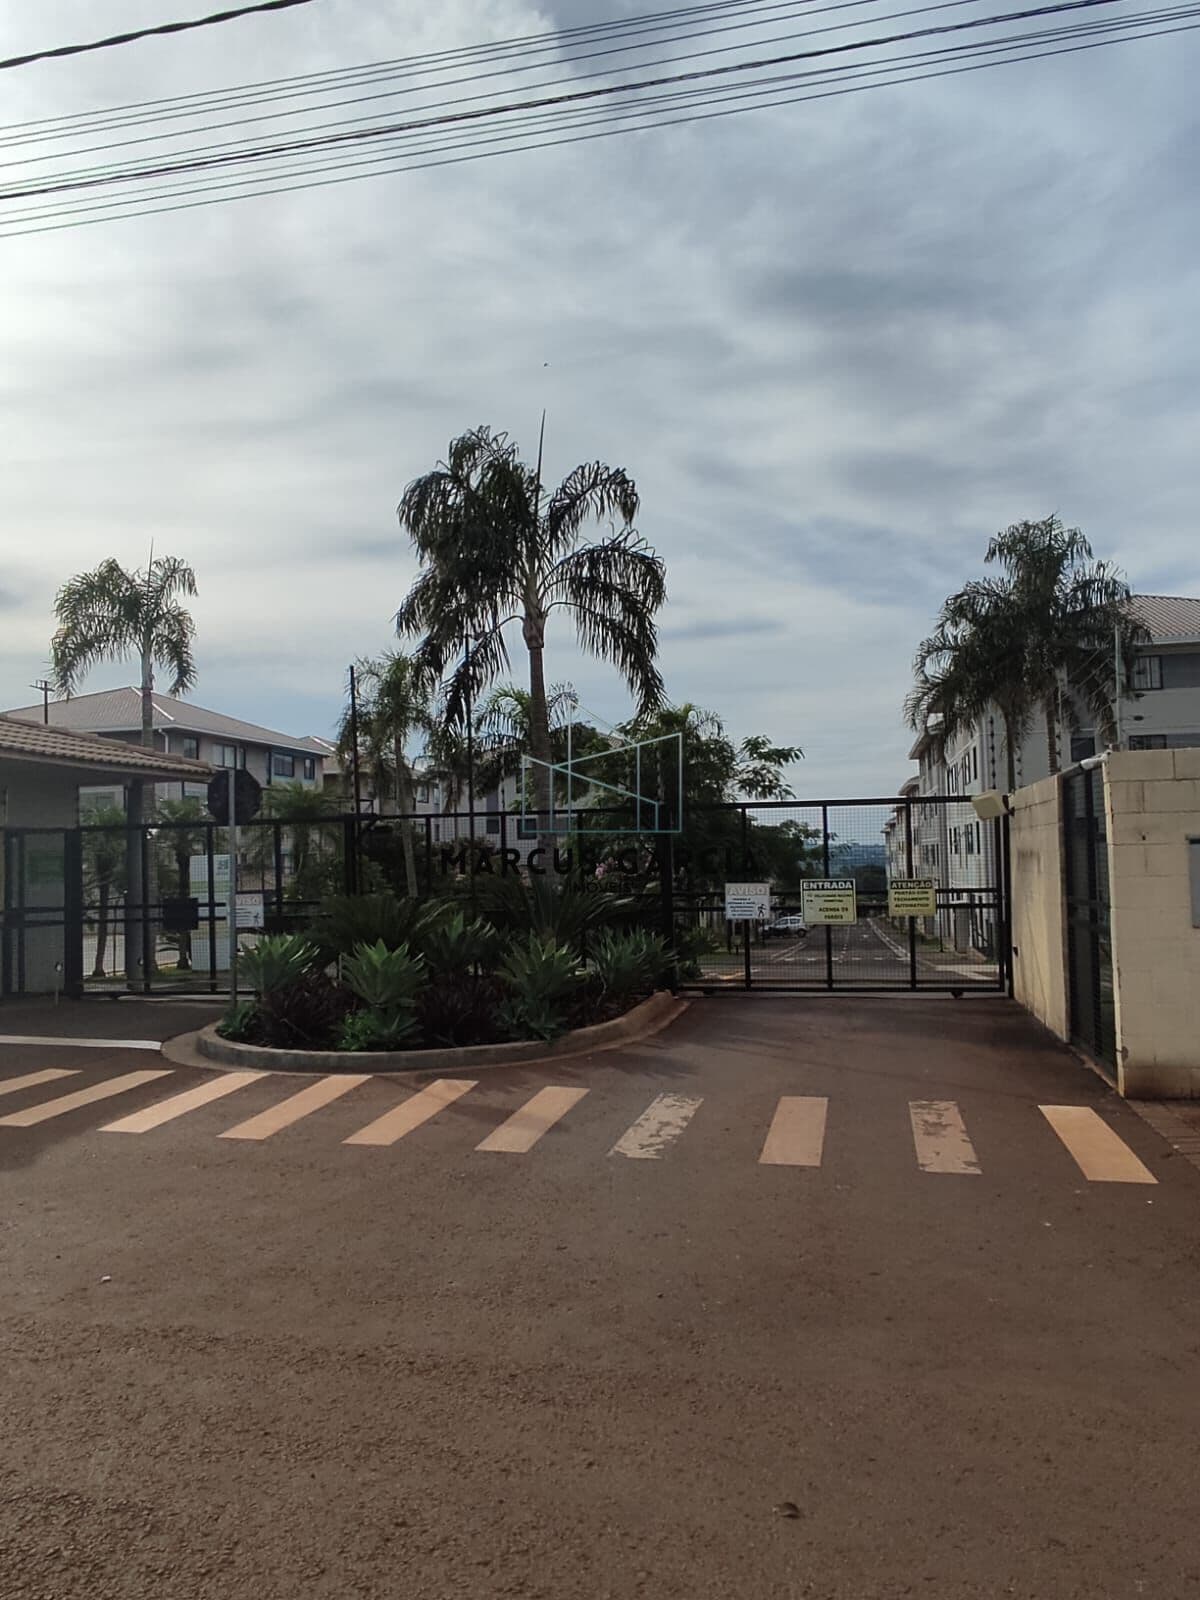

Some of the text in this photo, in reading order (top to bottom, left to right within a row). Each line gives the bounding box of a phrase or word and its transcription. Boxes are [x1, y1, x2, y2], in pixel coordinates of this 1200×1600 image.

[803, 881, 852, 889] ENTRADA
[891, 880, 932, 889] ATENÇÃO
[729, 886, 766, 896] AVISO
[235, 897, 259, 905] VISO
